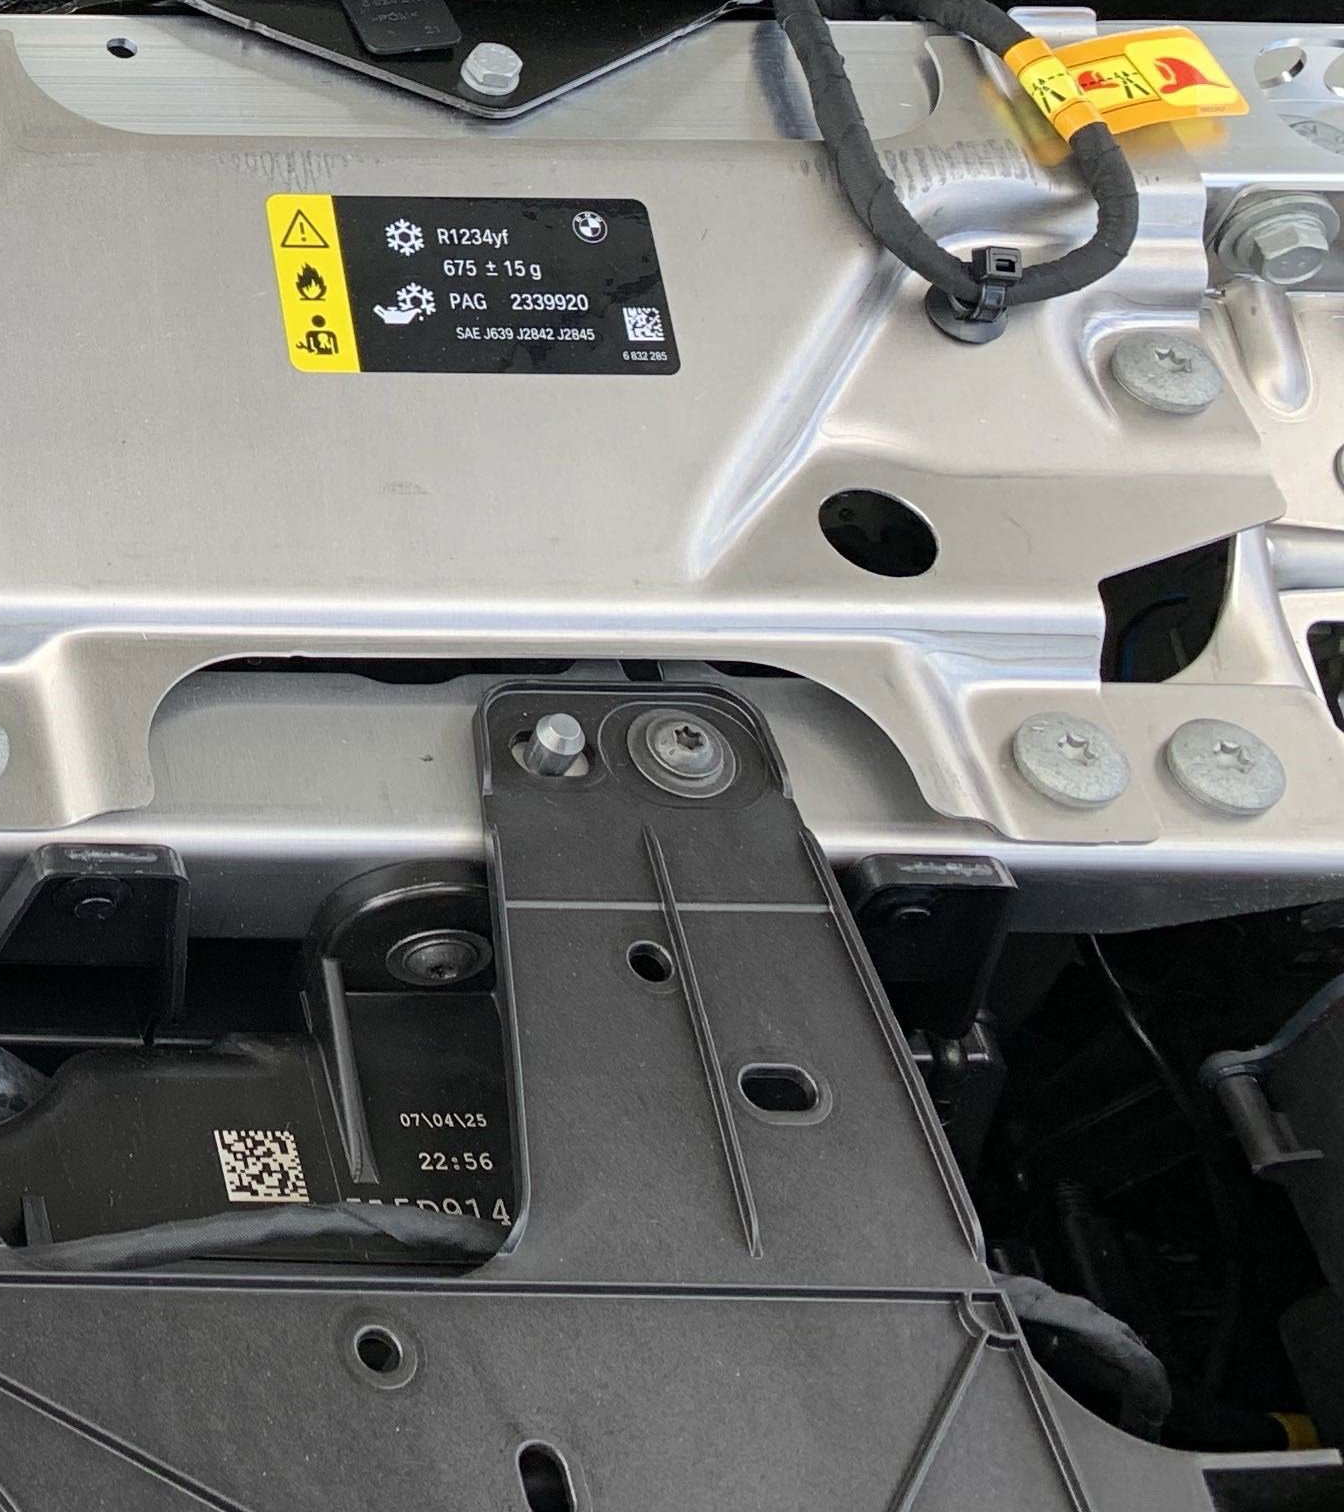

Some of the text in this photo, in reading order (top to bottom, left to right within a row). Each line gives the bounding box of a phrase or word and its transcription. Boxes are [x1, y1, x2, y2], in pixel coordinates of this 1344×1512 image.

[437, 228, 509, 247] R1234yf
[443, 260, 542, 281] 675 ± 15 g
[449, 293, 589, 311] PAG 2339920
[456, 327, 595, 341] SAE J639 J2842 J2845
[629, 352, 648, 361] 832
[650, 352, 668, 361] 285
[399, 1112, 488, 1128] 07\04\25
[418, 1152, 494, 1171] 22:56
